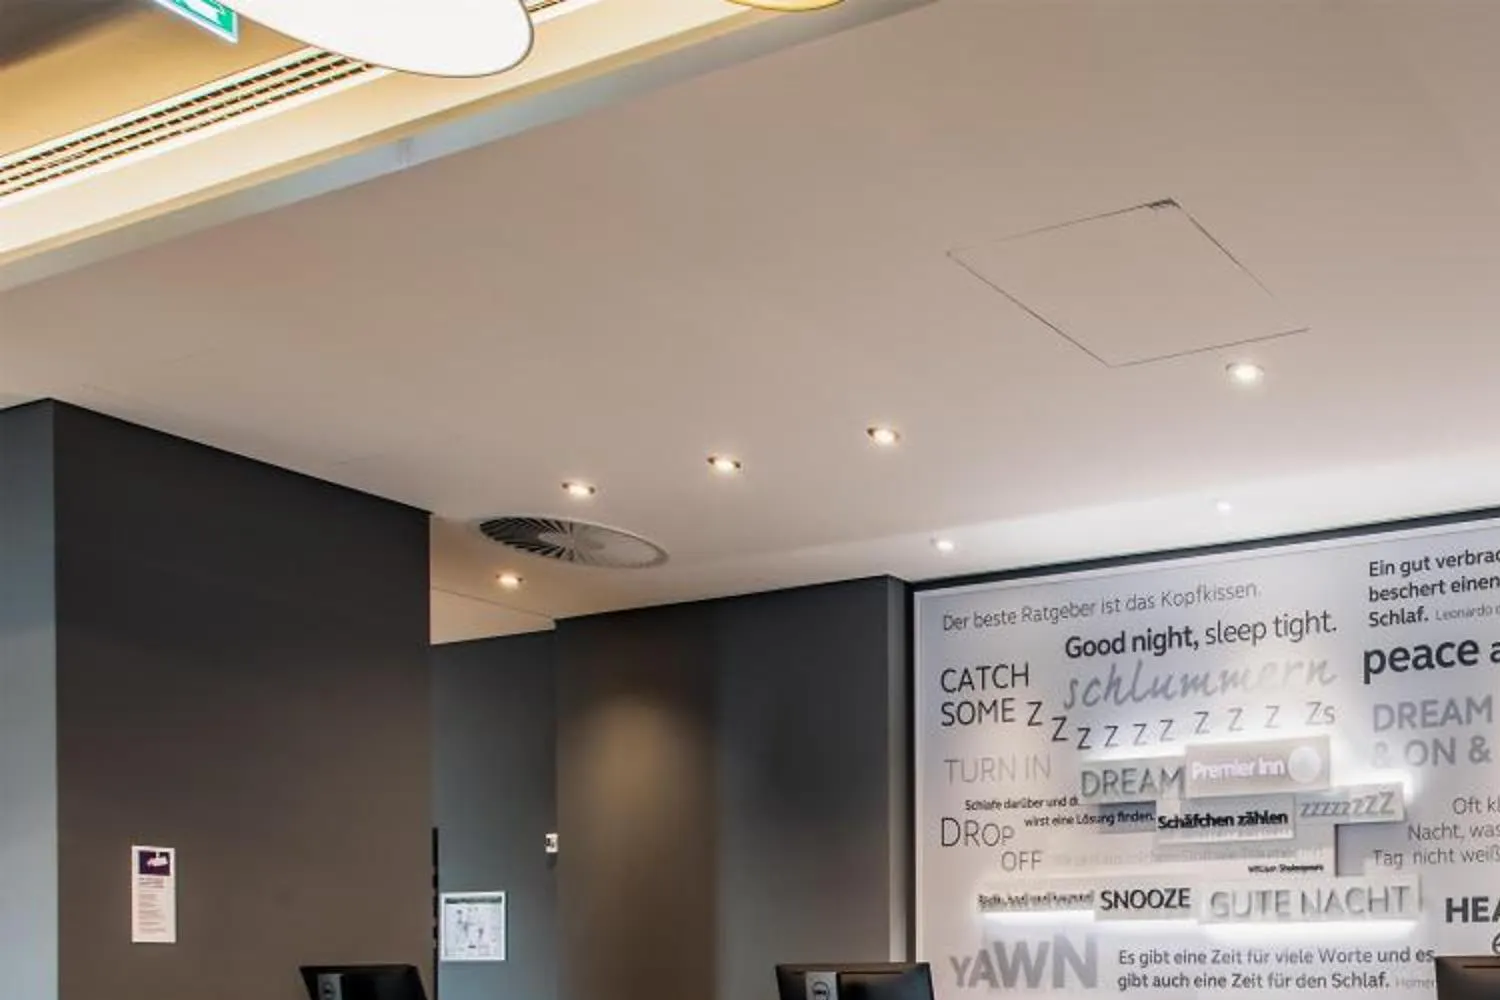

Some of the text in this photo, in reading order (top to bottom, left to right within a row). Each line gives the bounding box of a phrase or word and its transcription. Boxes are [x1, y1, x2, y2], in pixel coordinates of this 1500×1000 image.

[1368, 560, 1396, 577] Ein
[1400, 556, 1431, 579] gut
[1368, 579, 1446, 602] beschert
[1451, 574, 1500, 594] einen
[942, 582, 1262, 631] Der beste Ratgeber ist das Kopfkissen.
[1368, 605, 1429, 627] Schlaf.
[1434, 603, 1492, 622] Leonardo
[1065, 610, 1338, 659] Good night, sleep tight.
[1363, 638, 1480, 685] peace
[940, 661, 1030, 694] CATCH
[1063, 656, 1339, 709] schlummern
[940, 698, 1336, 750] SOME Z Z Z Z Z Z Z Z Z Zs
[1372, 694, 1493, 734] DREAM
[1404, 737, 1456, 768] ON
[1468, 734, 1494, 763] &
[943, 753, 1051, 786] TURN IN
[1081, 765, 1185, 799] DREAM
[1191, 756, 1286, 782] Premier Inn
[1003, 797, 1044, 810] darüber
[1047, 796, 1068, 808] und
[1452, 795, 1483, 816] Oft
[940, 816, 1016, 848] DROP
[1024, 809, 1156, 828] wirst eine Lösung finden.
[1157, 809, 1289, 830] Schäfchen zählen
[1407, 822, 1464, 842] Nacht,
[1000, 849, 1045, 872] OFF
[1373, 848, 1404, 871] Tag
[1413, 846, 1454, 866] nicht
[1099, 887, 1192, 912] SNOOZE
[1209, 884, 1410, 920] GUTE NACHT
[947, 931, 1097, 990] YAWN
[1118, 947, 1436, 969] Es gibt eine Zeit für viele Worte und es
[1117, 973, 1150, 991] gibt
[1152, 973, 1191, 989] auch
[1193, 973, 1227, 989] eine
[1231, 973, 1264, 989] Zeit
[1267, 972, 1290, 989] für
[1295, 972, 1328, 989] den
[1331, 972, 1390, 989] Schlaf.
